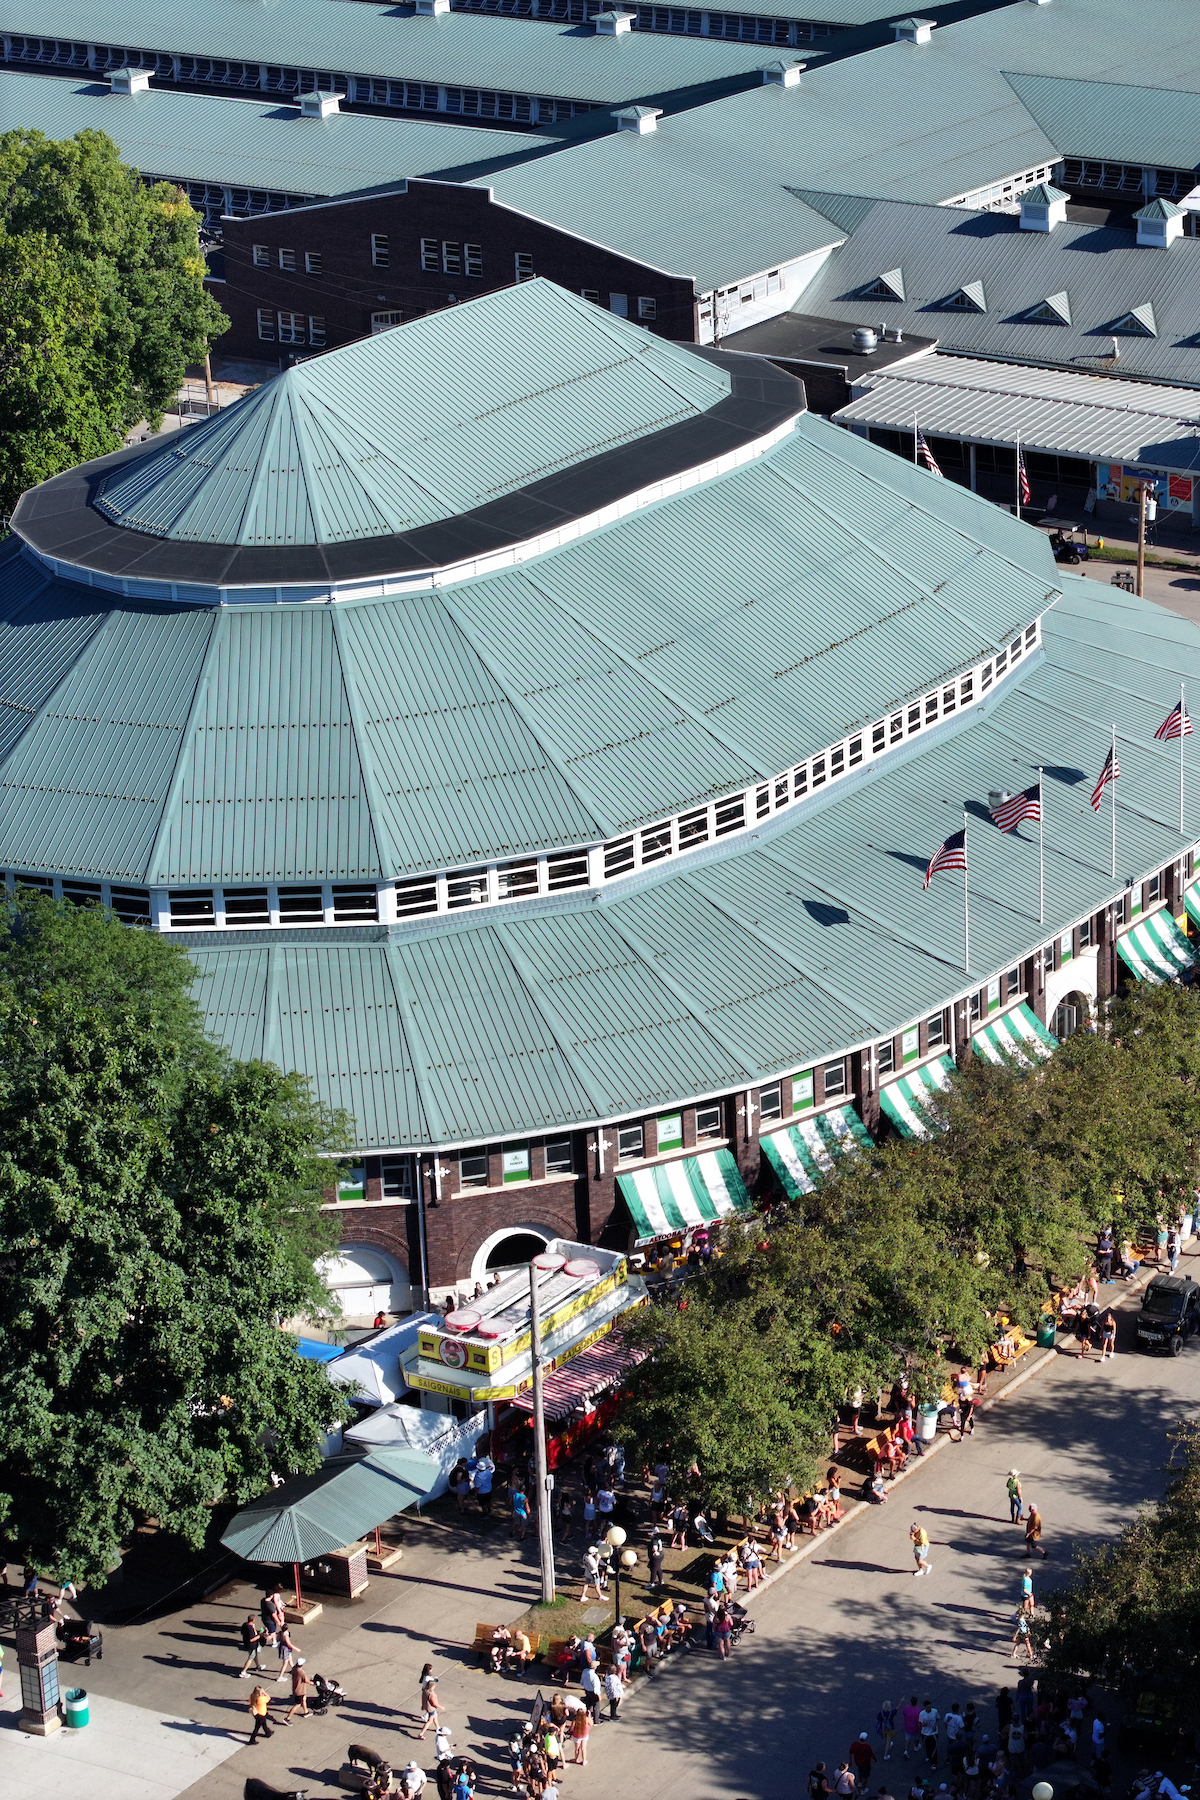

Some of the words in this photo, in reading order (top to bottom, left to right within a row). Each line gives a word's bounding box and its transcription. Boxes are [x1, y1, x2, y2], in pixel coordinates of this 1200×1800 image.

[649, 1230, 681, 1244] ALTOONA
[562, 1326, 607, 1362] SAIGONAIS
[491, 1350, 498, 1366] S
[418, 1378, 461, 1396] SAIGONAIS
